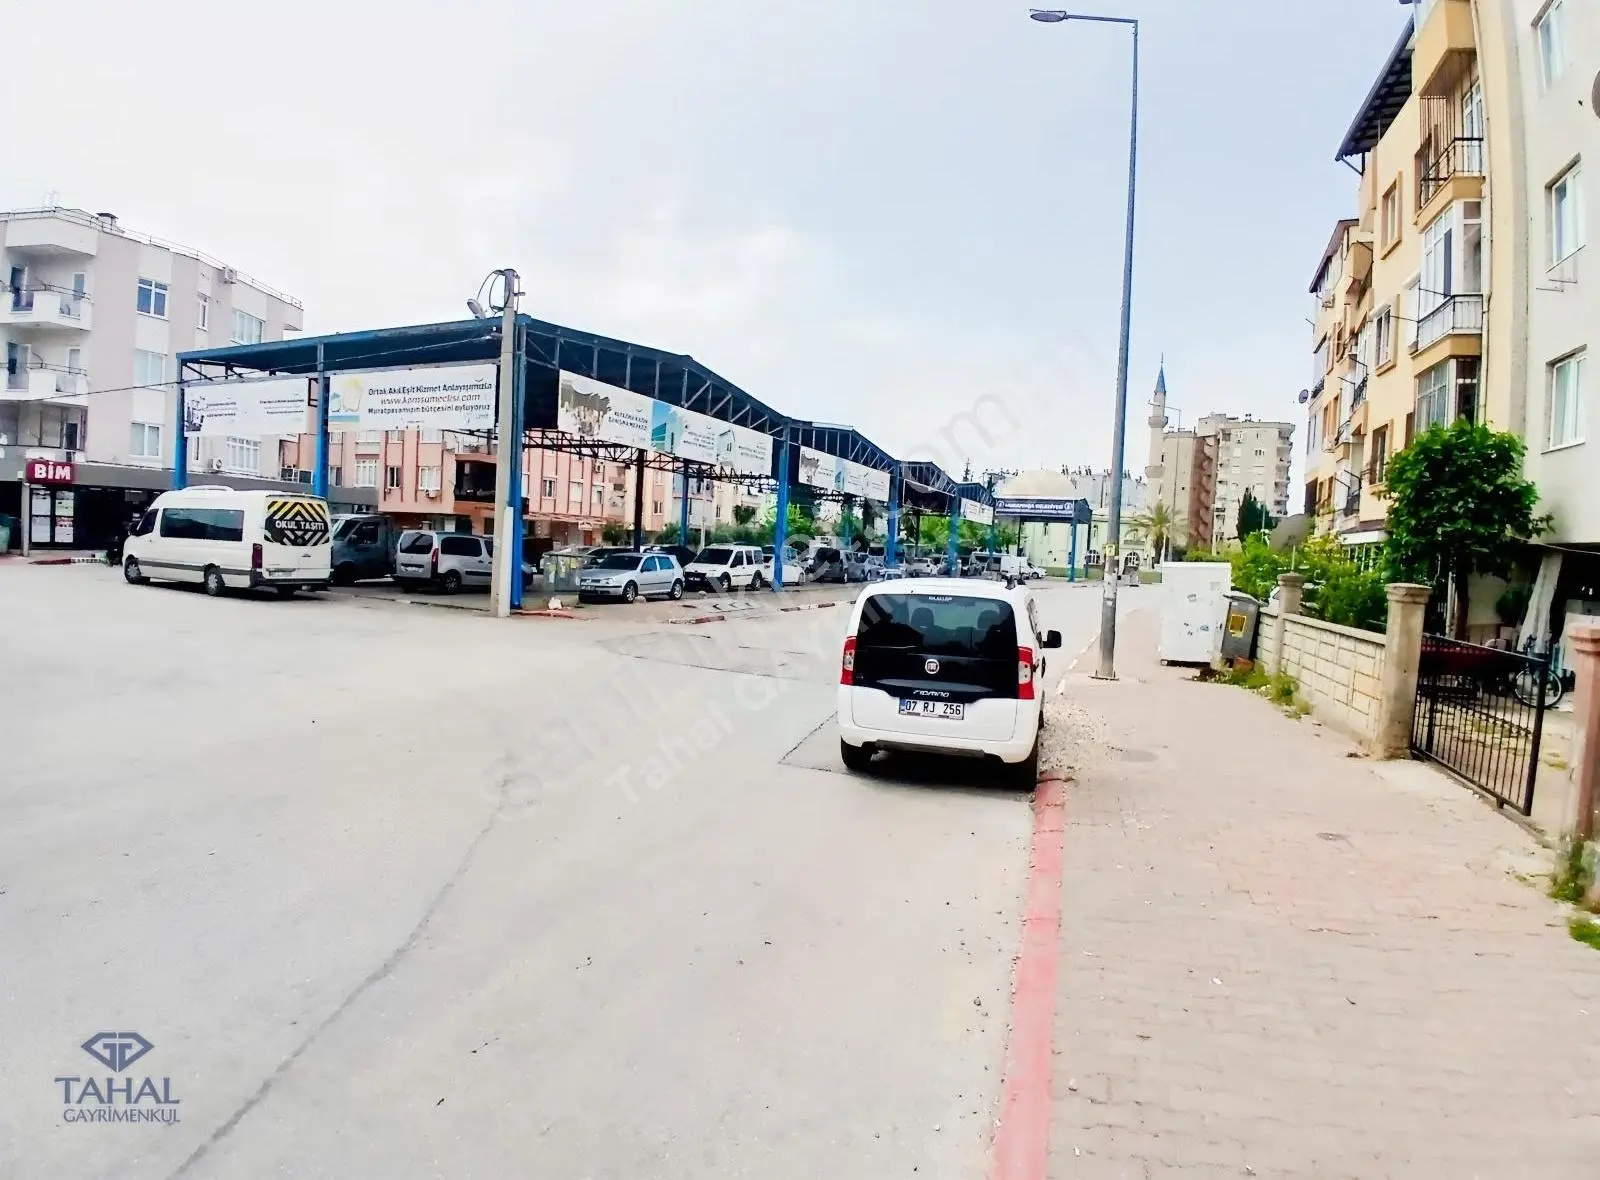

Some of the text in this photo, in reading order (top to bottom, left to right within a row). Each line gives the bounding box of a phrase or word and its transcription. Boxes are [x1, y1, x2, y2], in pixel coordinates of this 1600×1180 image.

[368, 388, 387, 396] Ortak
[416, 385, 441, 393] Hizmet
[34, 461, 71, 480] BİM
[275, 520, 298, 529] OKUL
[905, 700, 961, 716] 07 RJ 256
